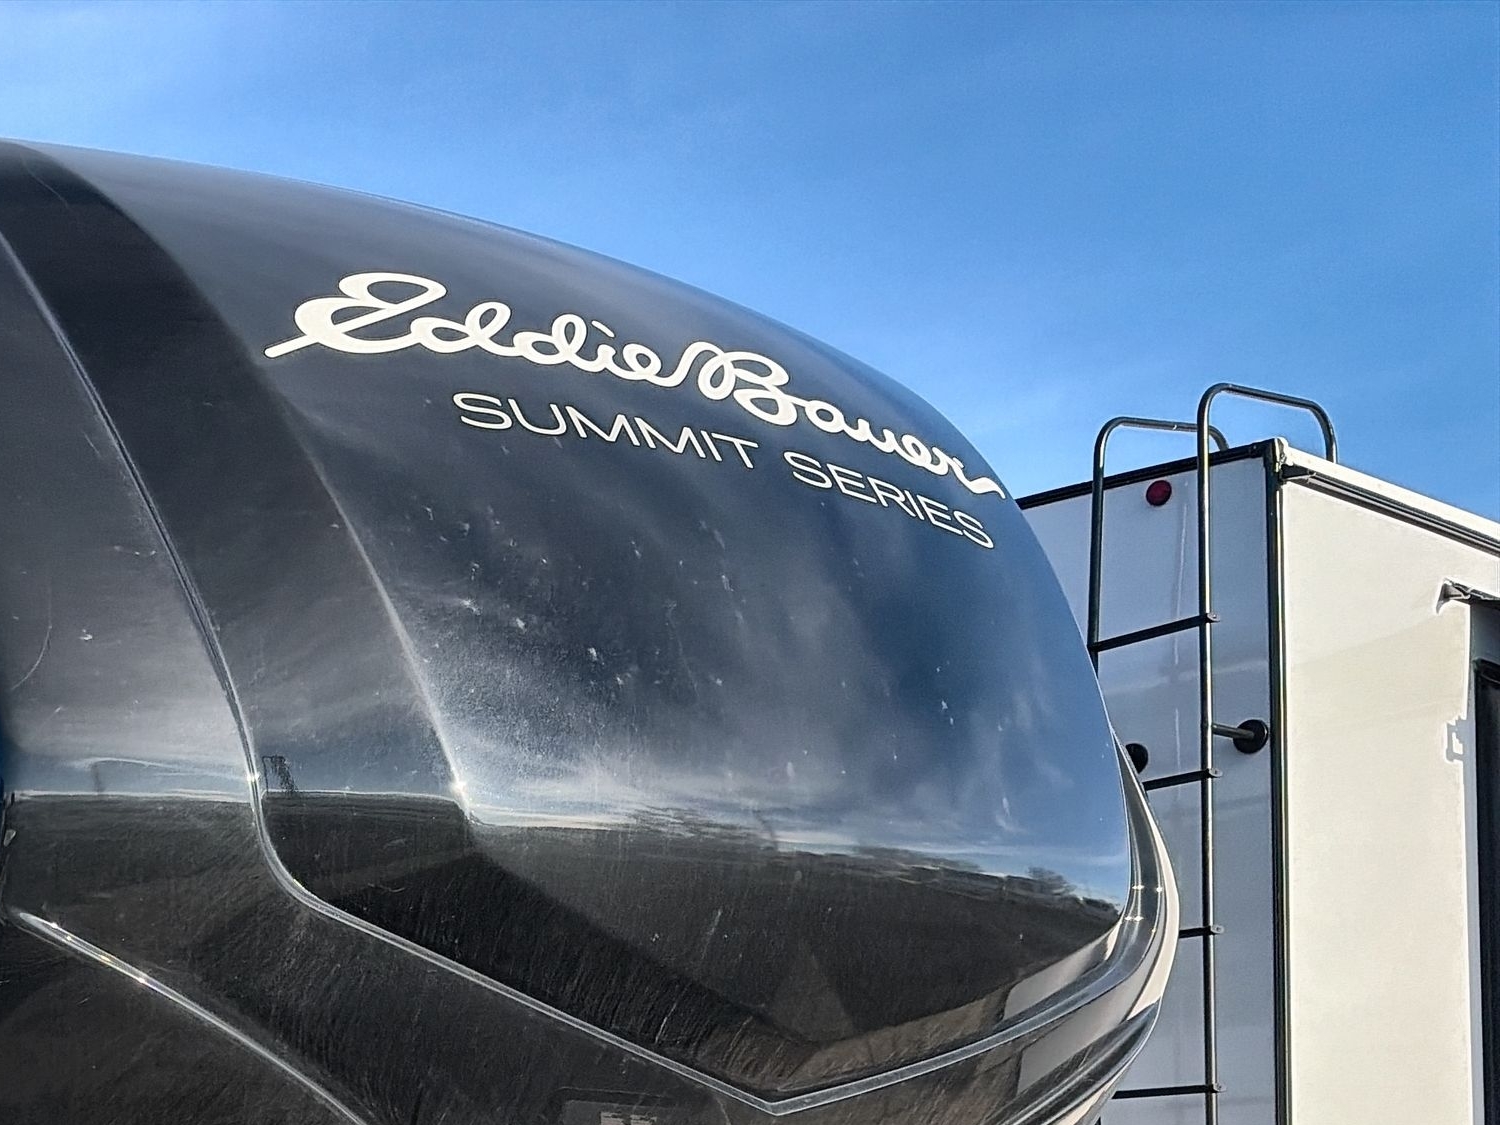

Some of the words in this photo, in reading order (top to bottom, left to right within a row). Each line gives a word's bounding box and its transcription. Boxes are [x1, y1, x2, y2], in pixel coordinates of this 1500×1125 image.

[264, 272, 682, 388] Eddie
[678, 341, 1005, 499] Bauer
[452, 391, 759, 470] SUMMIT
[782, 450, 996, 550] SERIES
